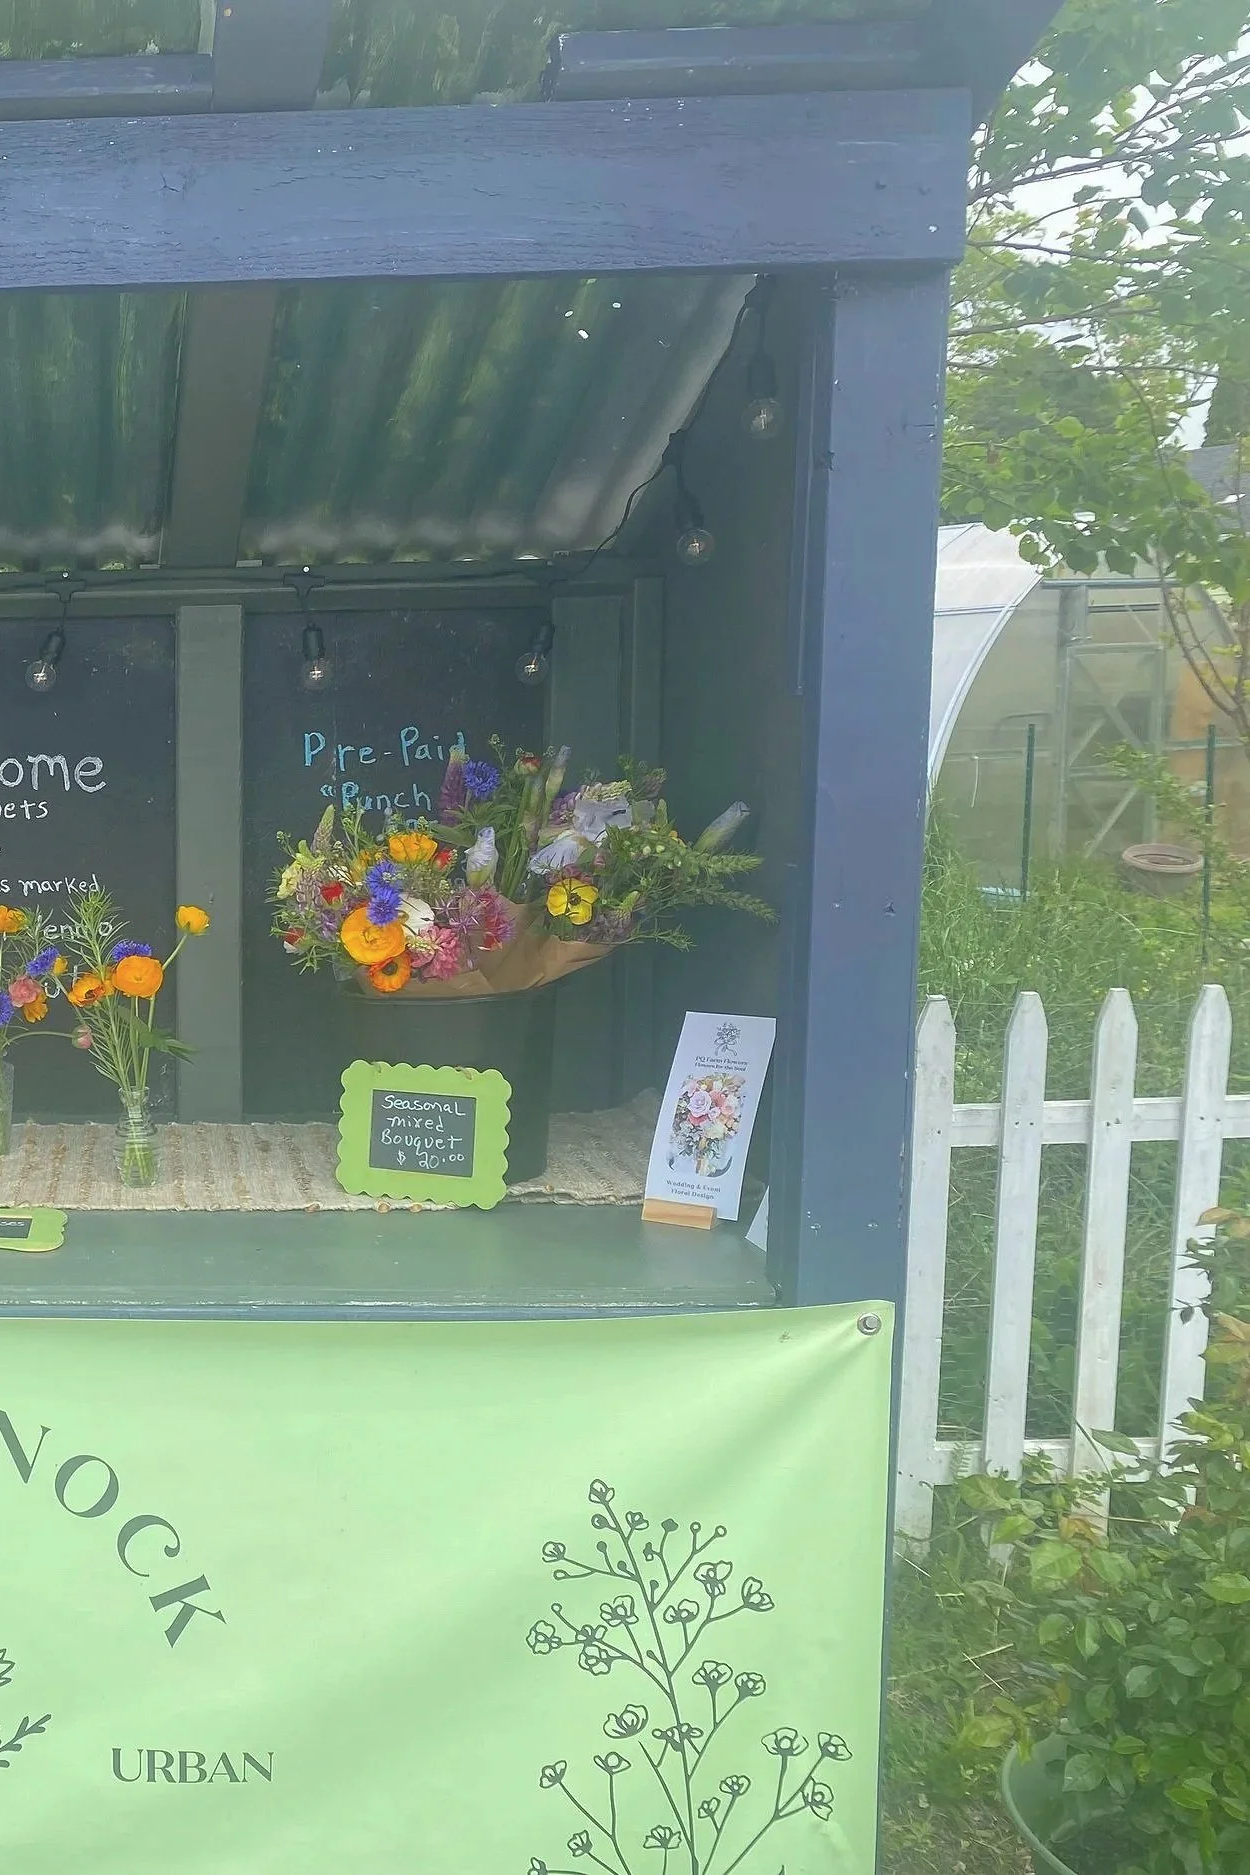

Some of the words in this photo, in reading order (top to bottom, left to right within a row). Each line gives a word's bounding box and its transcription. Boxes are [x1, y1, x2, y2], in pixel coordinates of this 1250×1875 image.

[304, 726, 466, 771] Pre-Paid
[18, 874, 99, 895] marked
[381, 1129, 463, 1156] Bouquet
[666, 1179, 695, 1190] Wedding
[691, 1191, 715, 1200] Design
[110, 1747, 275, 1786] URBAN
